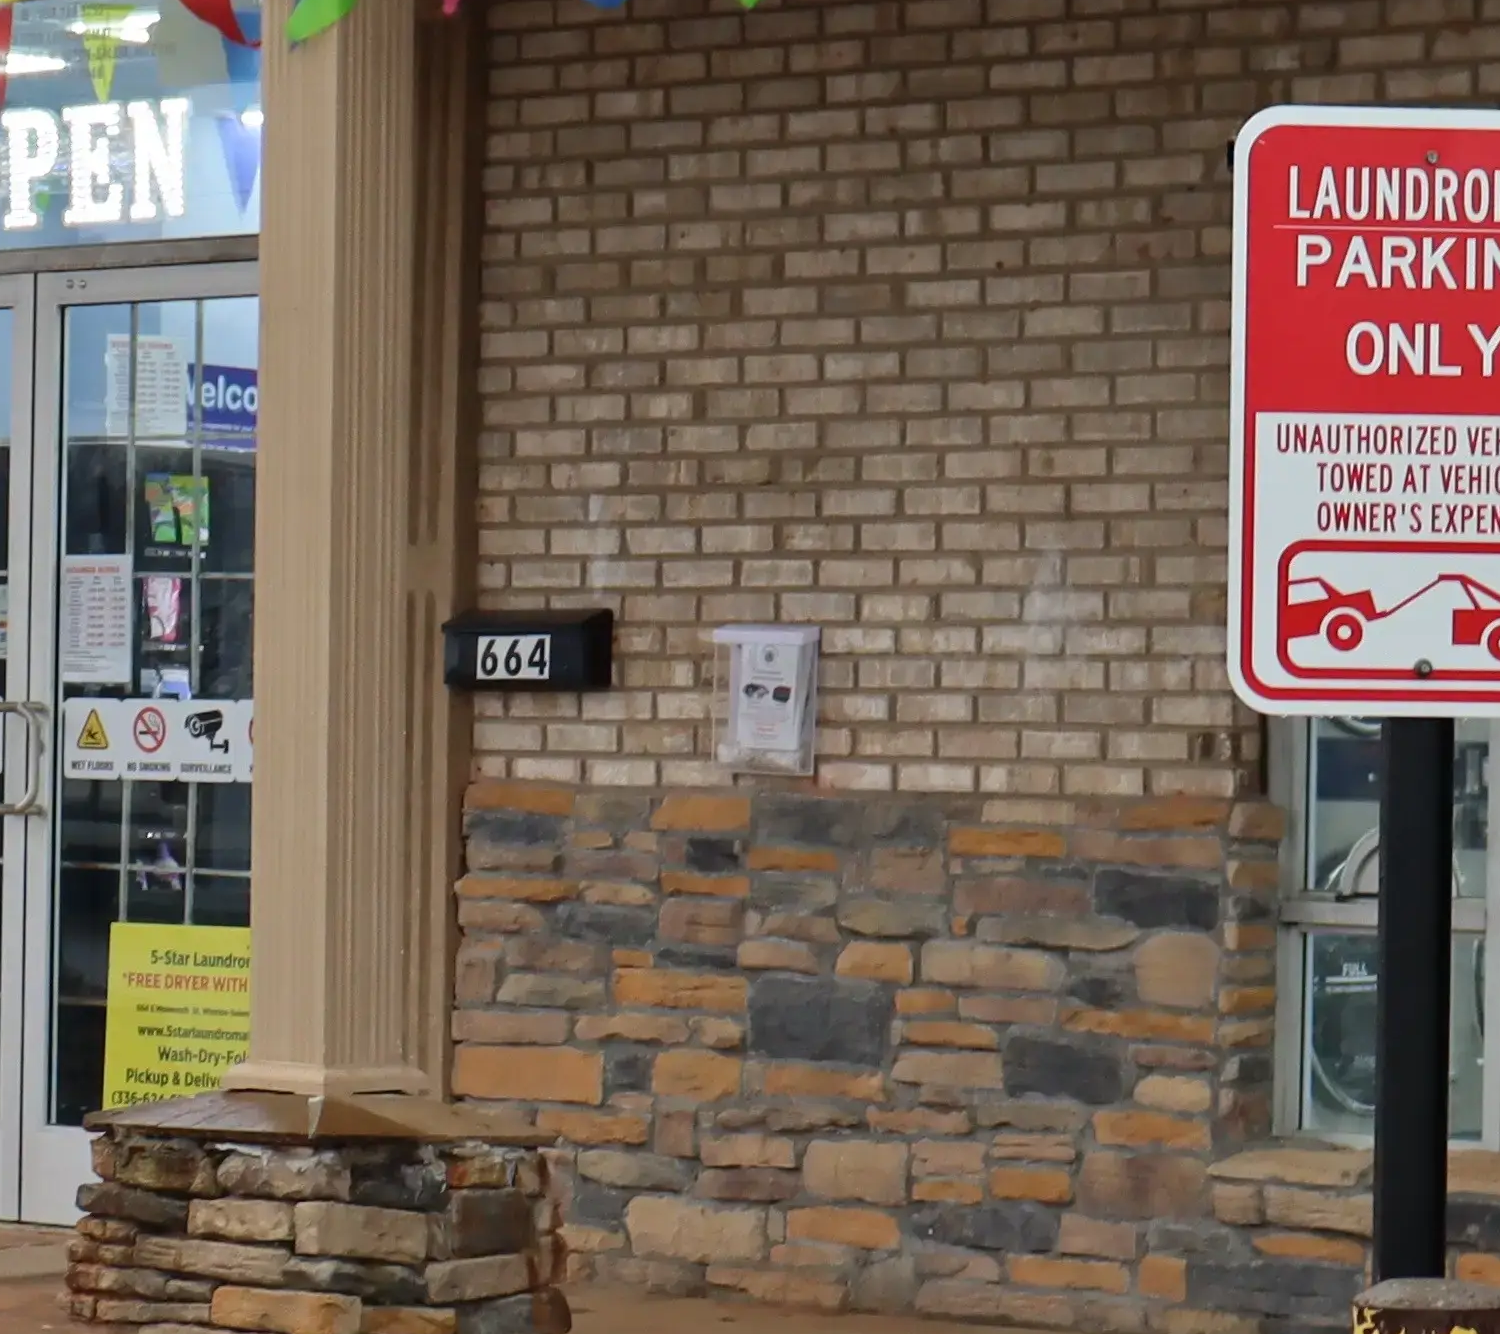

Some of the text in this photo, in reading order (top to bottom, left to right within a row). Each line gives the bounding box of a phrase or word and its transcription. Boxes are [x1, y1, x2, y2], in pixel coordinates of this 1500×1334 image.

[1277, 423, 1457, 456] UNAUTHORIZED
[1317, 462, 1393, 493] TOWED
[1402, 463, 1431, 494] AT
[1317, 503, 1423, 532] OWNER'S
[480, 638, 547, 676] 664
[151, 950, 190, 966] 5-Star
[164, 974, 208, 991] DRYER
[212, 977, 248, 993] WITH
[158, 1046, 249, 1066] Wash-Dry-Fol
[126, 1068, 169, 1086] Pickup
[172, 1071, 180, 1085] &
